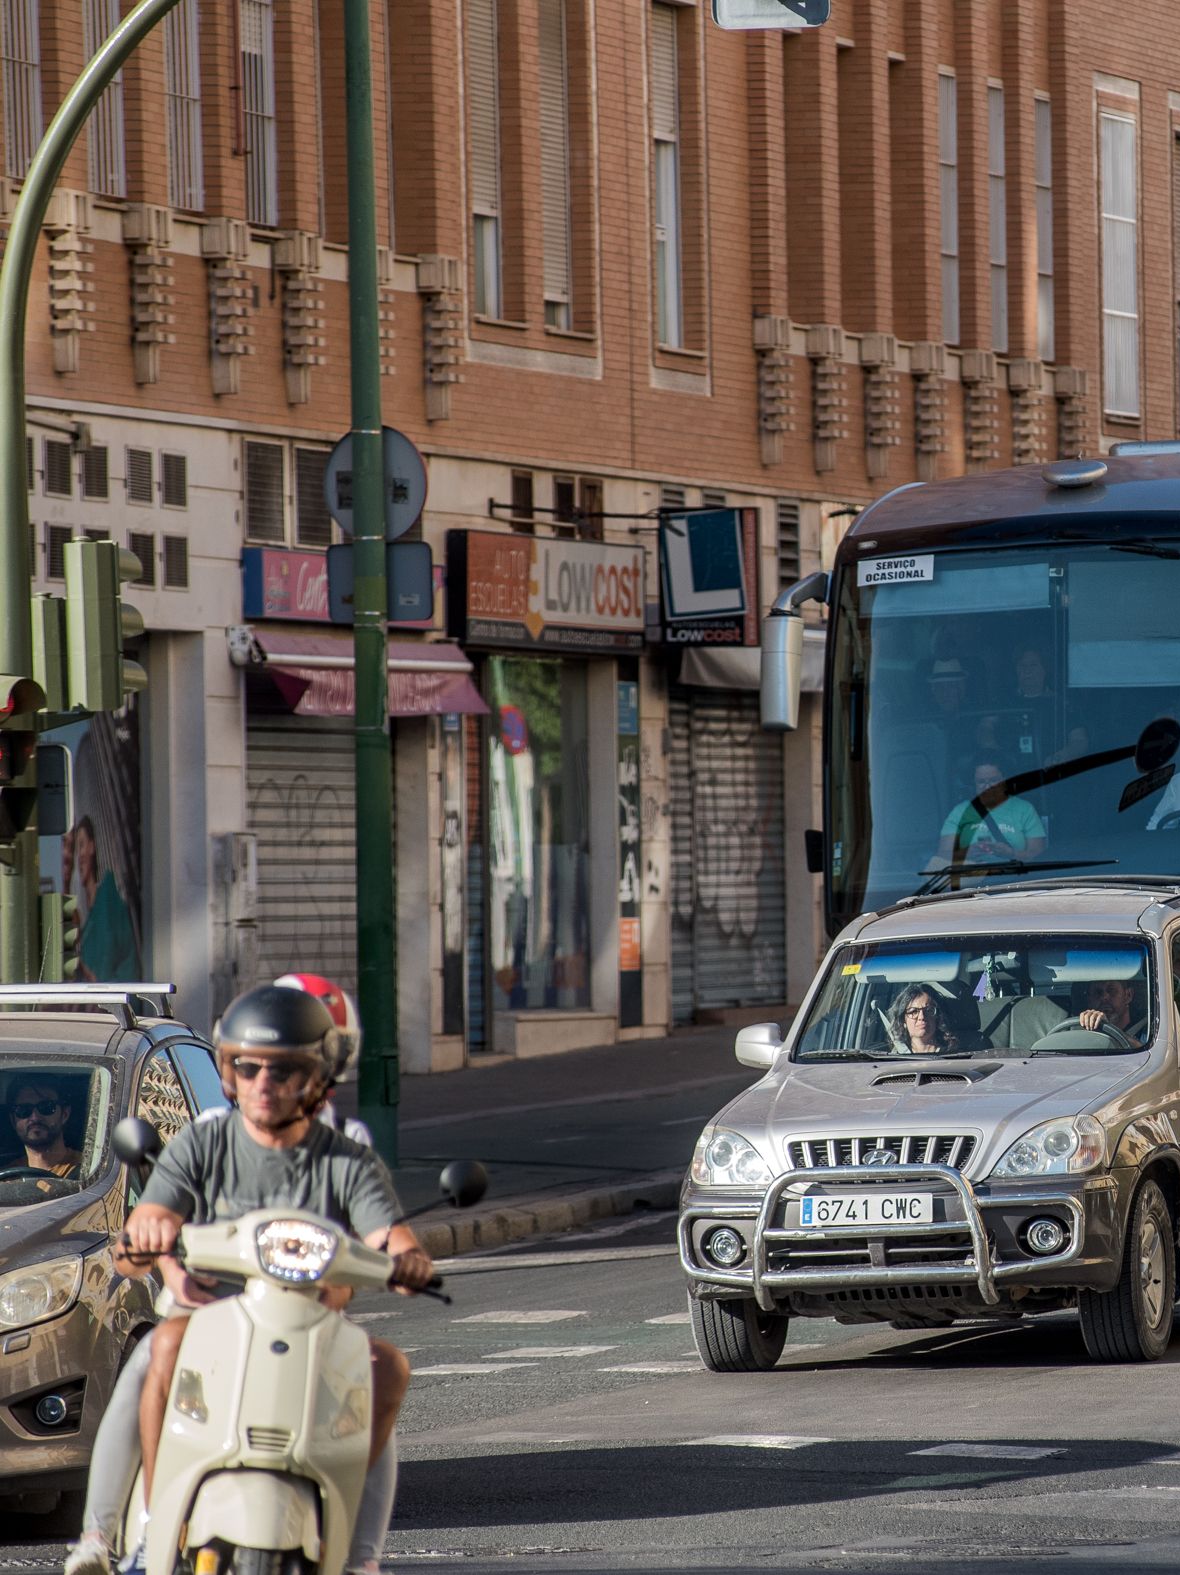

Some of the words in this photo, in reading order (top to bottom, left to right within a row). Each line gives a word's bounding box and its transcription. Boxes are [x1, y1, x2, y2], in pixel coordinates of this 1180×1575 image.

[494, 550, 527, 579] AUTO
[865, 569, 925, 582] OCASIONAL
[876, 559, 915, 570] SERVIÇO
[469, 581, 527, 614] ESCUELAS
[817, 1199, 868, 1221] 6741
[881, 1198, 922, 1220] CWC
